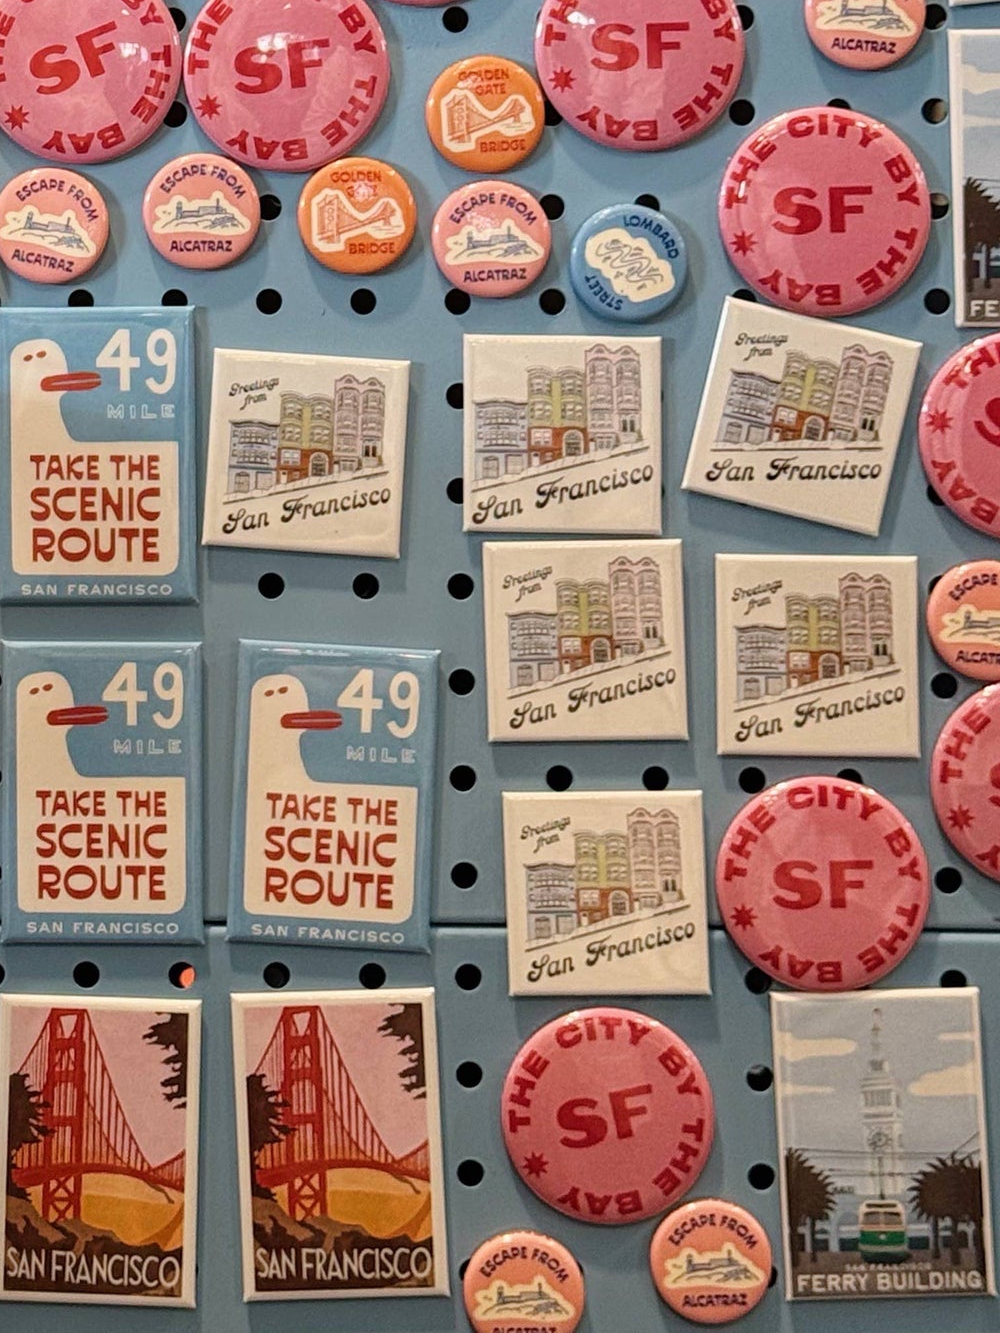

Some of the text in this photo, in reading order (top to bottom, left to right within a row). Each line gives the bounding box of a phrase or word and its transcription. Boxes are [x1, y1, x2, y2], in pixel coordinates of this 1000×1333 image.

[29, 21, 118, 96] SF
[590, 21, 690, 72] SF
[831, 37, 896, 54] ALCATRAZ
[130, 44, 173, 125] THE
[41, 122, 126, 154] BAY
[724, 114, 920, 306] THE CITY BY THE BAY
[771, 185, 873, 235] SF
[96, 328, 178, 394] 49
[228, 376, 280, 397] Greetings
[107, 404, 176, 419] MILE
[30, 454, 160, 480] TAKE THE
[705, 458, 882, 482] San Francisco
[30, 487, 161, 522] SCENIC
[221, 486, 391, 535] San Francisco
[31, 527, 159, 563] ROUTE
[21, 583, 173, 596] SAN FRANCISCO
[502, 566, 553, 591] Greetings
[103, 662, 184, 729] 49
[336, 669, 420, 738] 49
[510, 668, 676, 729] San Francisco
[113, 739, 182, 755] MILE
[347, 746, 415, 763] MILE
[36, 790, 167, 817] TAKE THE
[266, 792, 398, 826] TAKE THE
[36, 824, 167, 859] SCENIC
[520, 817, 570, 841] Greetings
[264, 827, 398, 867] SCENIC
[37, 865, 166, 900] ROUTE
[264, 867, 394, 909] ROUTE
[725, 784, 923, 983] THE CITY BY THE BAY
[772, 859, 873, 911] SF
[27, 922, 179, 934] SAN FRANCISCO
[251, 924, 405, 945] SAN FRANCISCO
[527, 922, 695, 982] San Francisco
[510, 1016, 705, 1215] THE CITY BY THE BAY
[556, 1084, 653, 1149] SF
[6, 1248, 180, 1286] SAN FRANCISCO
[256, 1247, 430, 1281] SAN FRANCISCO
[797, 1270, 983, 1292] FERRY BUILDING
